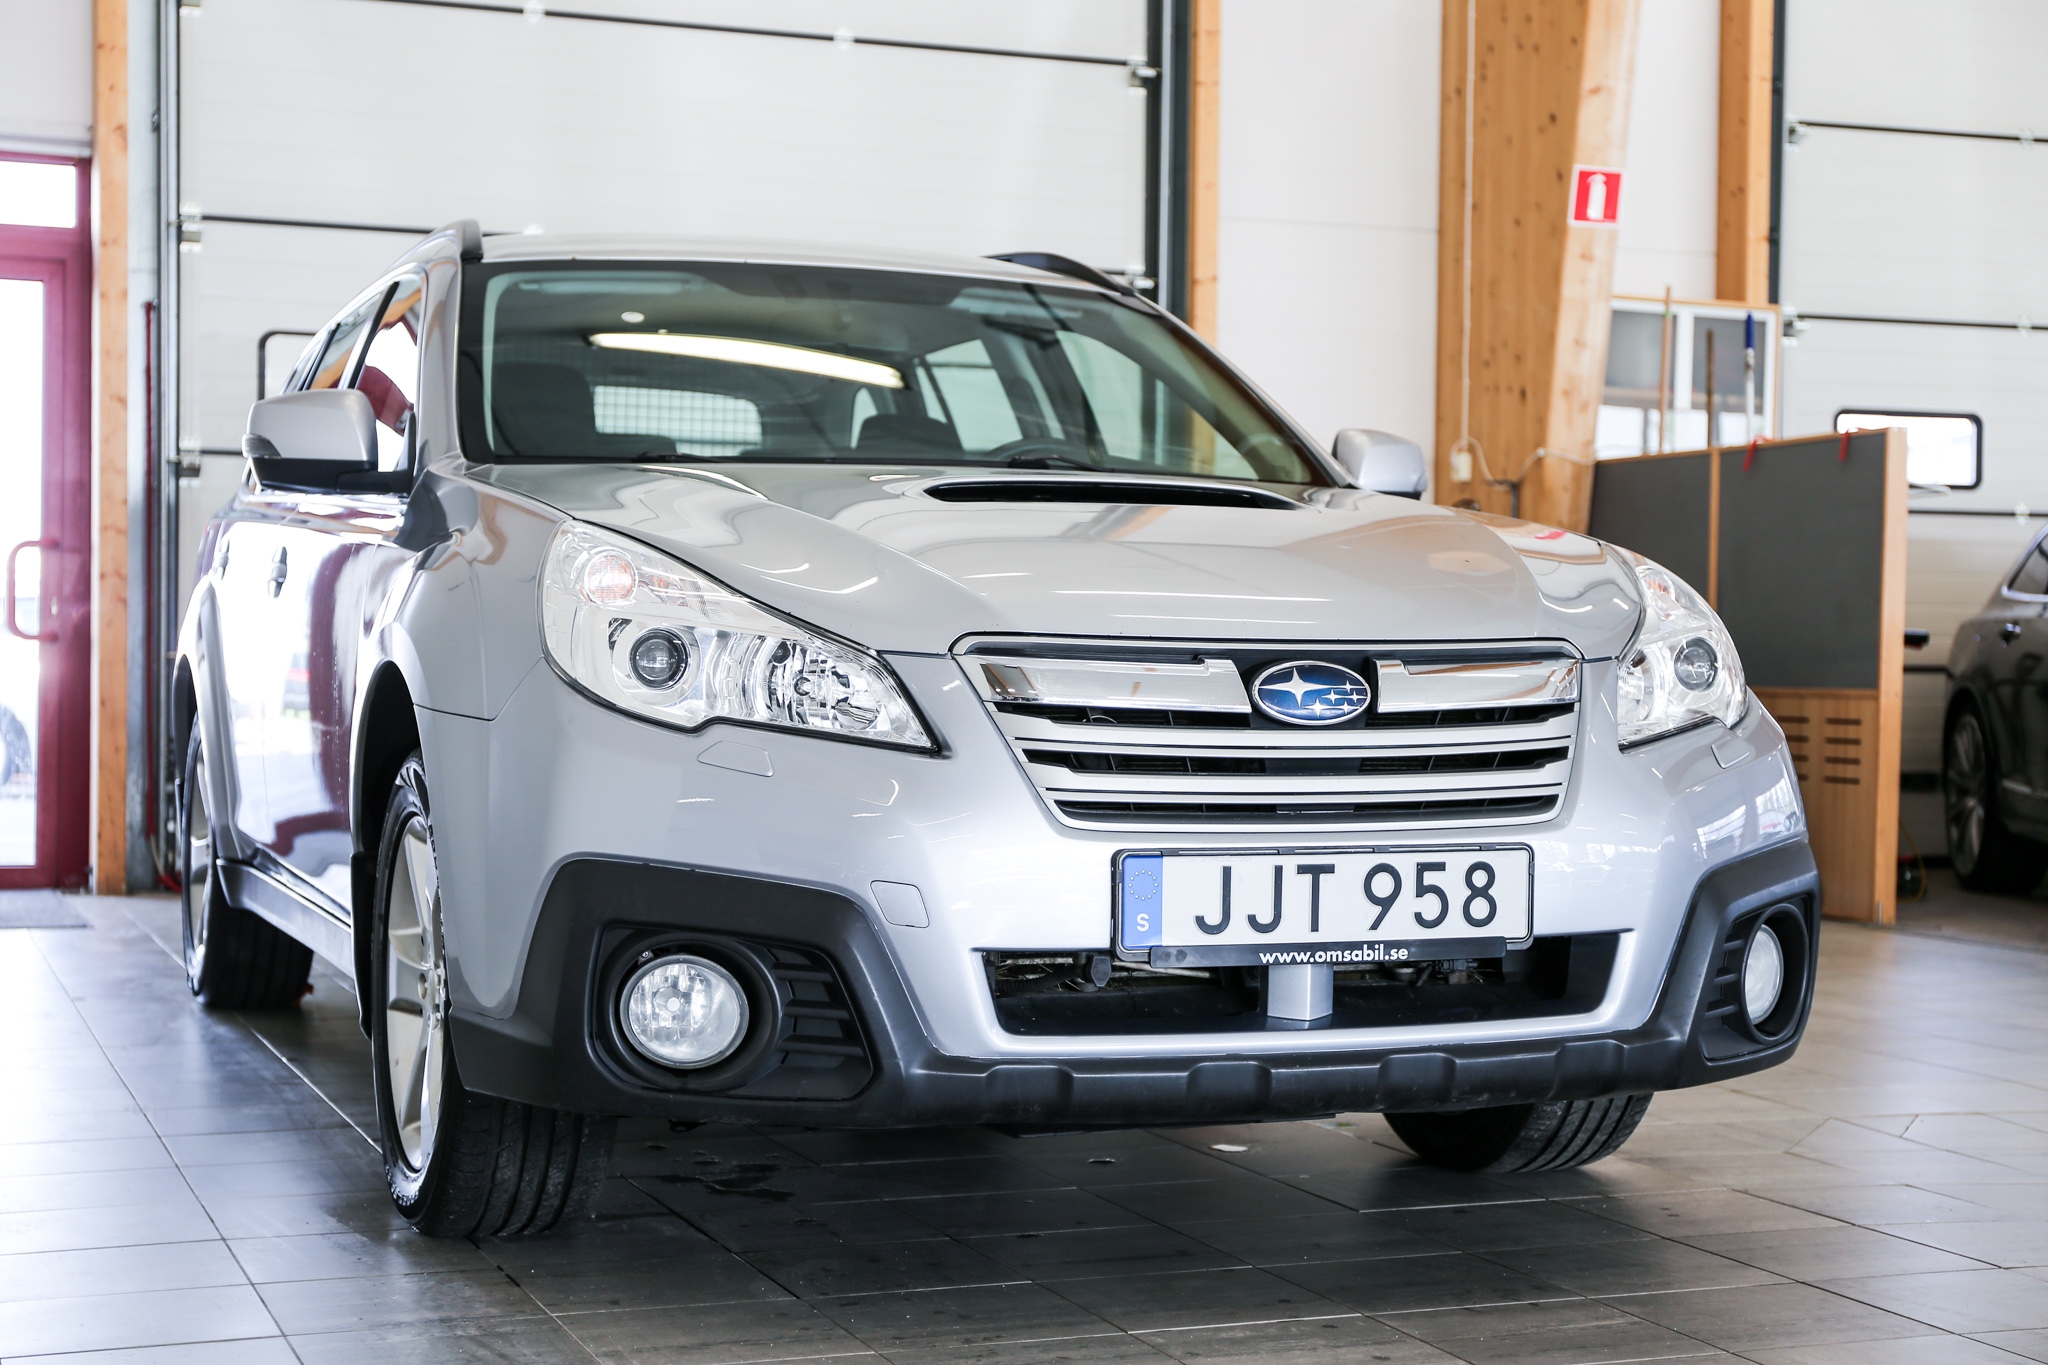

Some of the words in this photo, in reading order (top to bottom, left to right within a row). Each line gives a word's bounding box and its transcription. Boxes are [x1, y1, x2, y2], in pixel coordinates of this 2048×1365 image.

[1194, 863, 1336, 936] JJT
[1363, 861, 1498, 931] 958
[1135, 913, 1150, 933] S
[1258, 944, 1409, 964] www.omsabil.se
